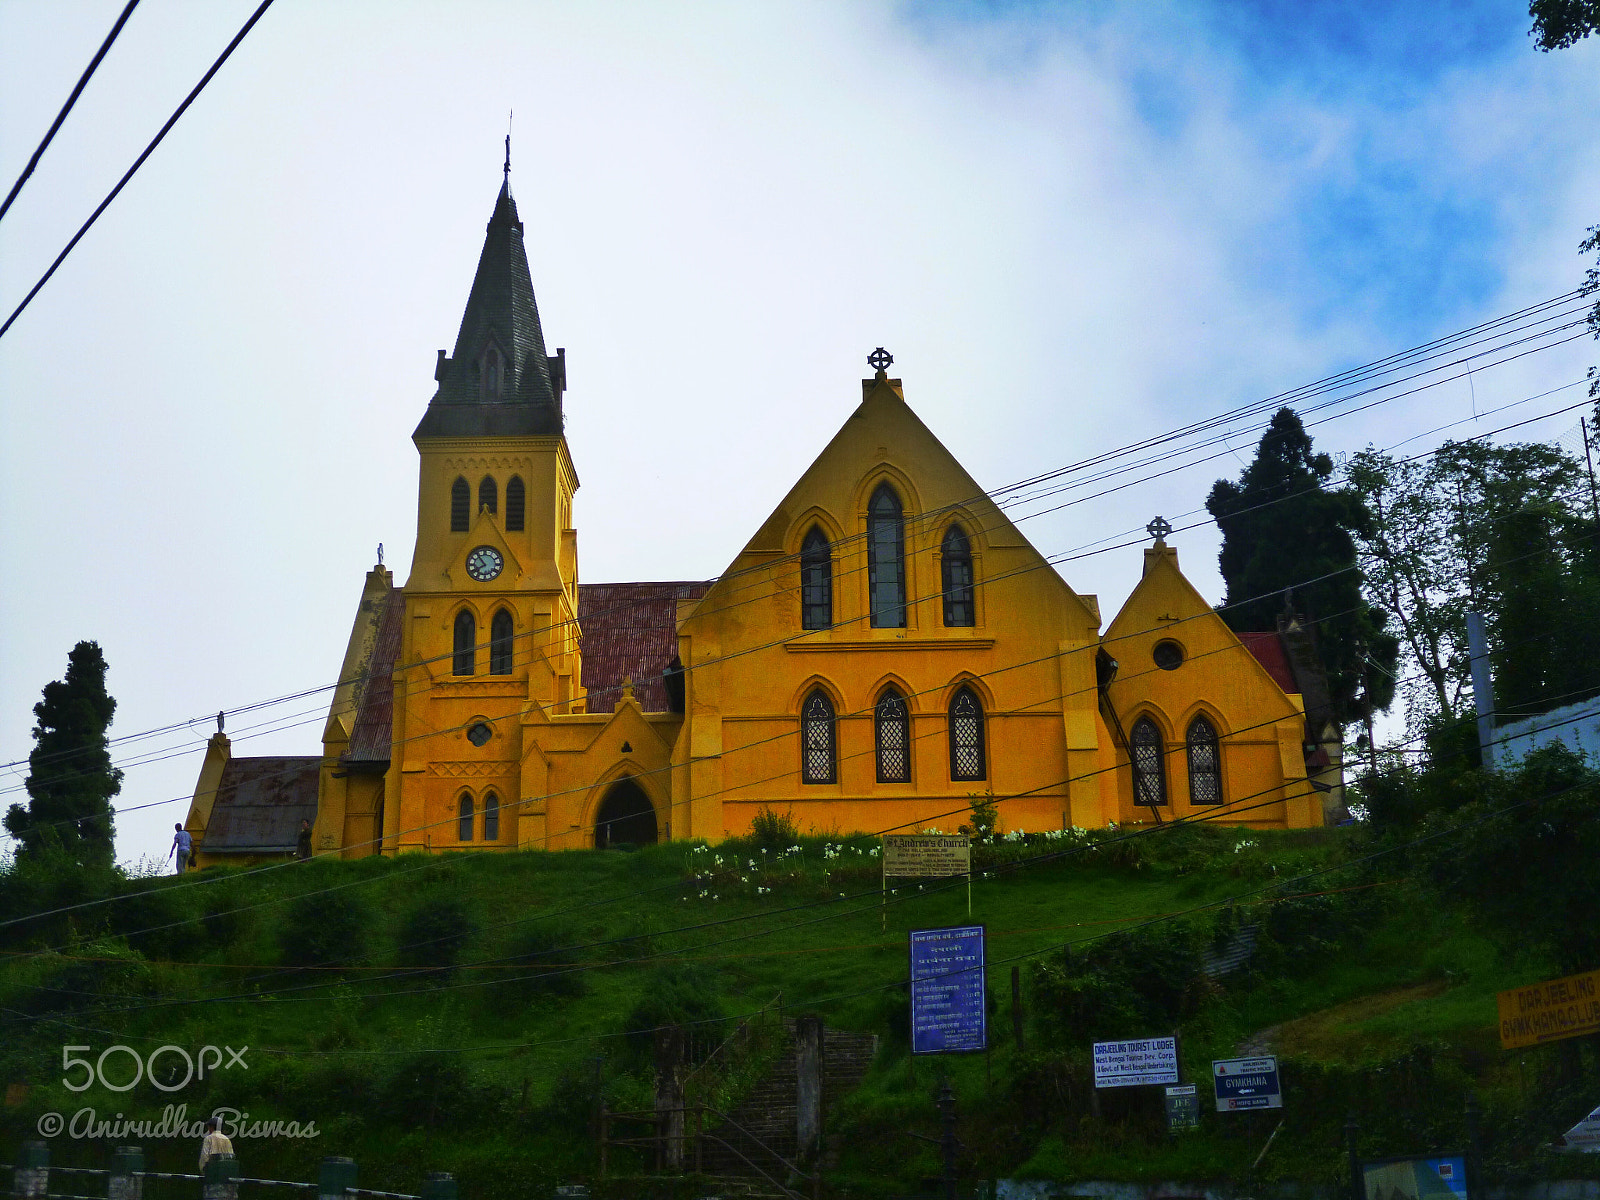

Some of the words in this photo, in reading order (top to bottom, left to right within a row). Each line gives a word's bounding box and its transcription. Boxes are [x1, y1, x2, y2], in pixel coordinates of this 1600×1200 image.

[937, 838, 968, 848] Church
[1095, 1043, 1126, 1055] DARJEELING
[1128, 1041, 1150, 1052] TOURIST
[1152, 1040, 1174, 1051] LODGE
[1095, 1056, 1108, 1064] West
[1108, 1055, 1125, 1064] Bengal
[1158, 1052, 1175, 1061] Corp.
[1132, 1063, 1146, 1072] Bengal
[1225, 1076, 1267, 1088] GYMKHANA
